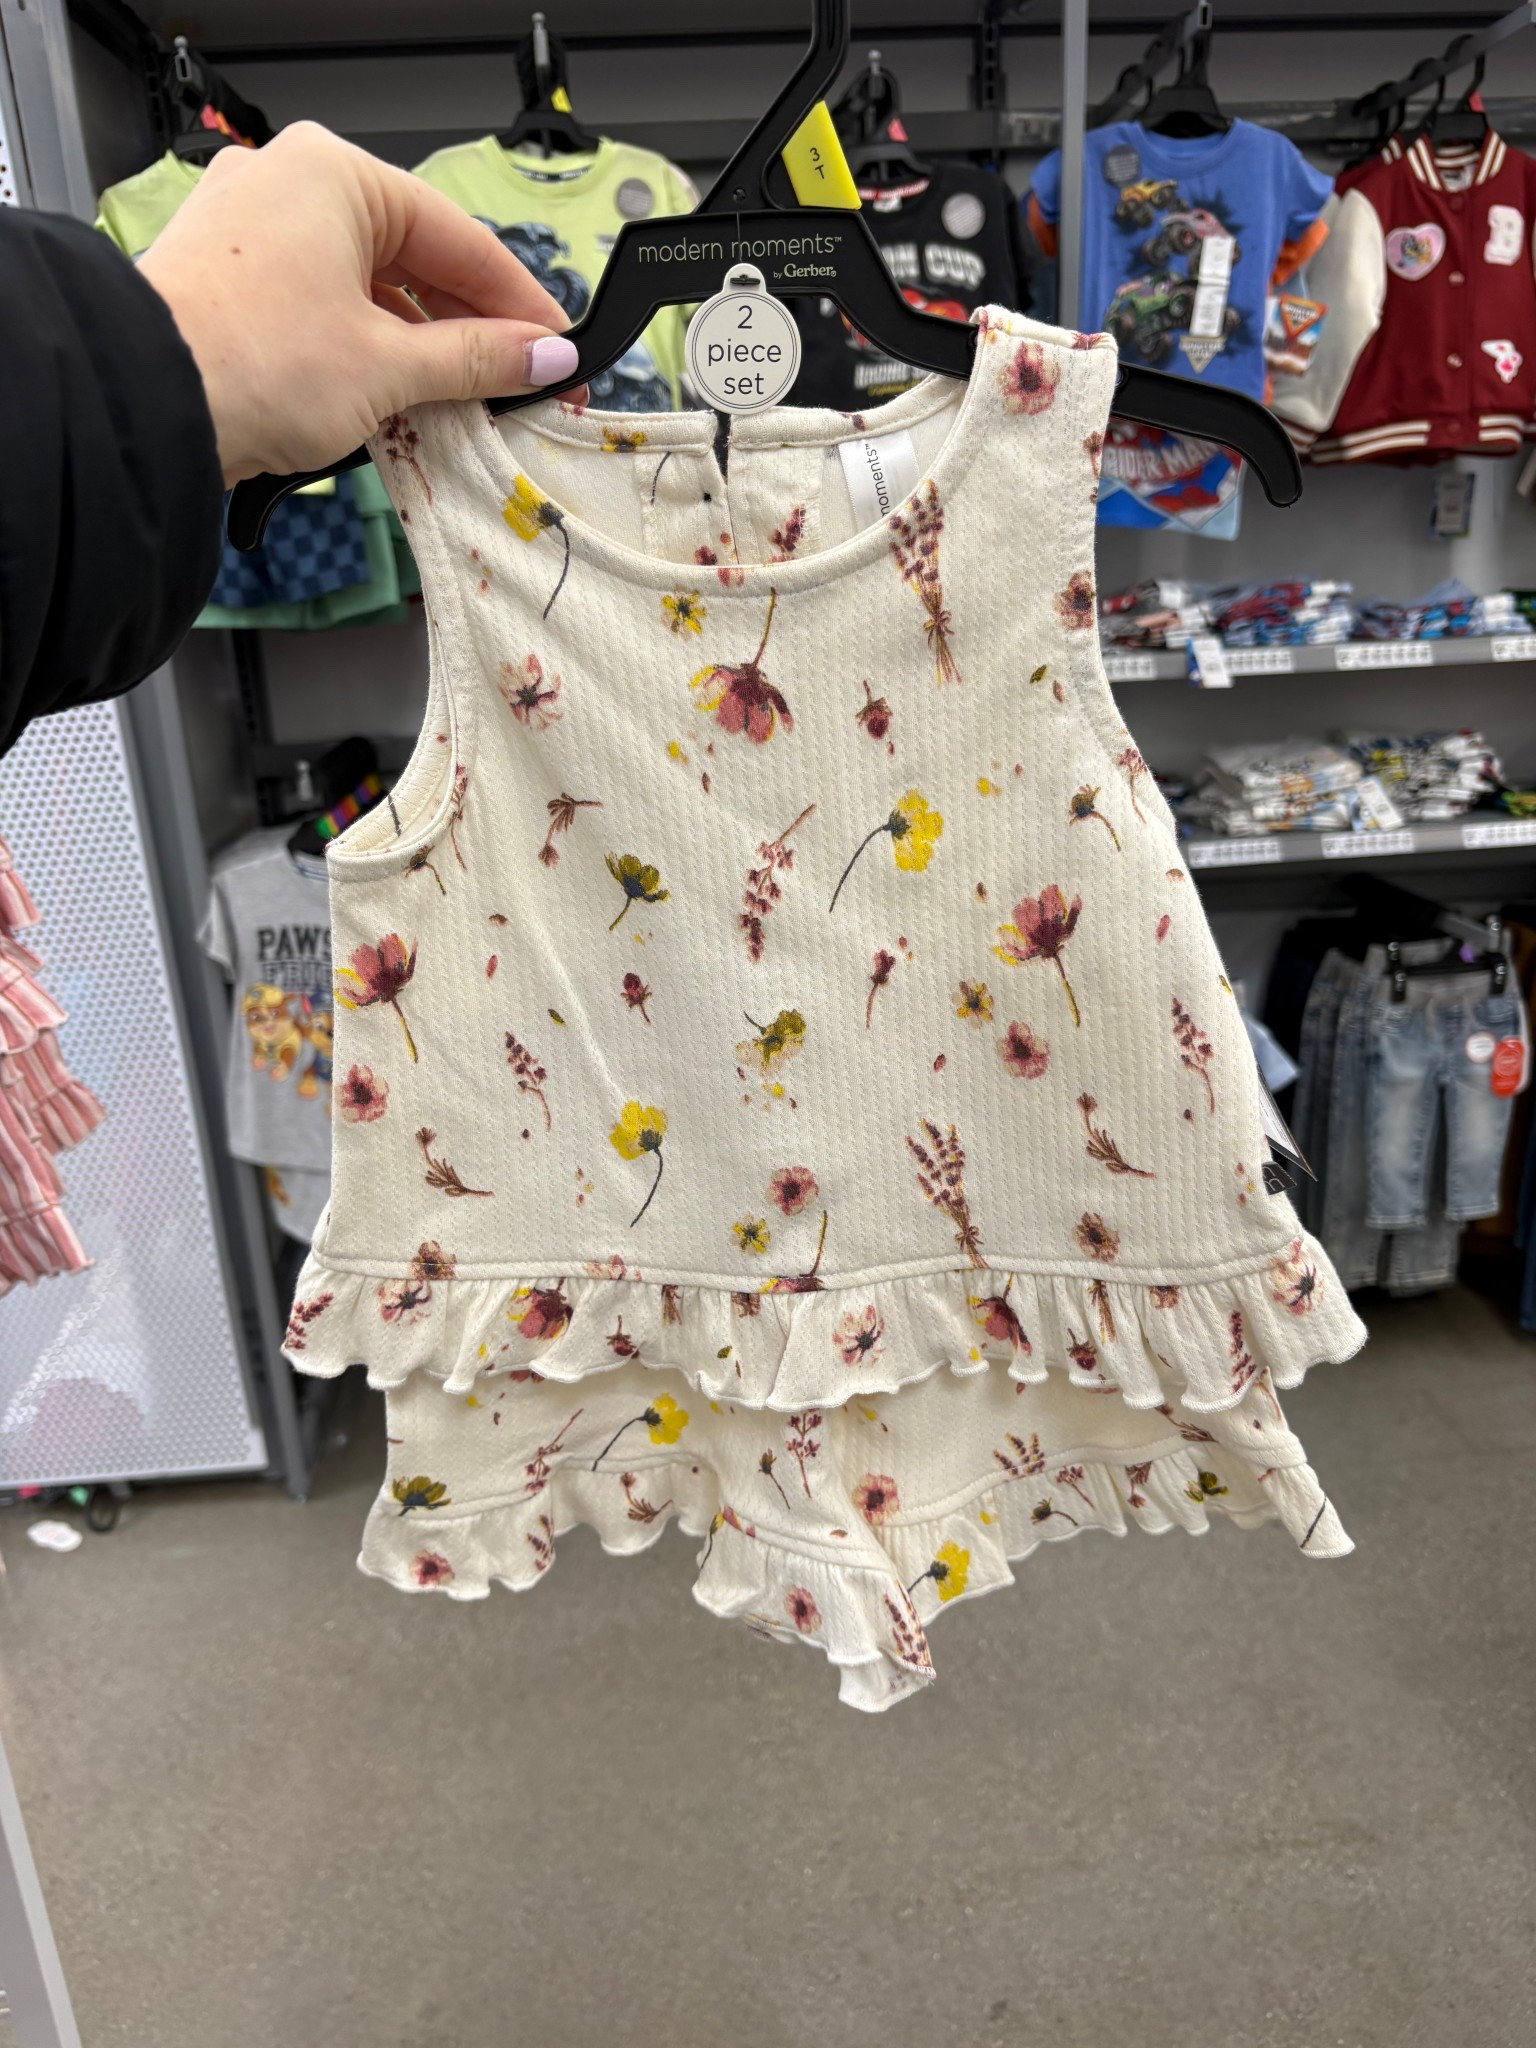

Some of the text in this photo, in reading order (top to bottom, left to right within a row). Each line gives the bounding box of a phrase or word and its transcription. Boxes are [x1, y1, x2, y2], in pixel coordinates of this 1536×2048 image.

[810, 147, 820, 162] 3
[815, 164, 824, 180] T
[638, 236, 723, 263] modern
[773, 271, 783, 280] by
[737, 304, 753, 329] 2
[708, 338, 782, 367] piece
[723, 372, 765, 395] set
